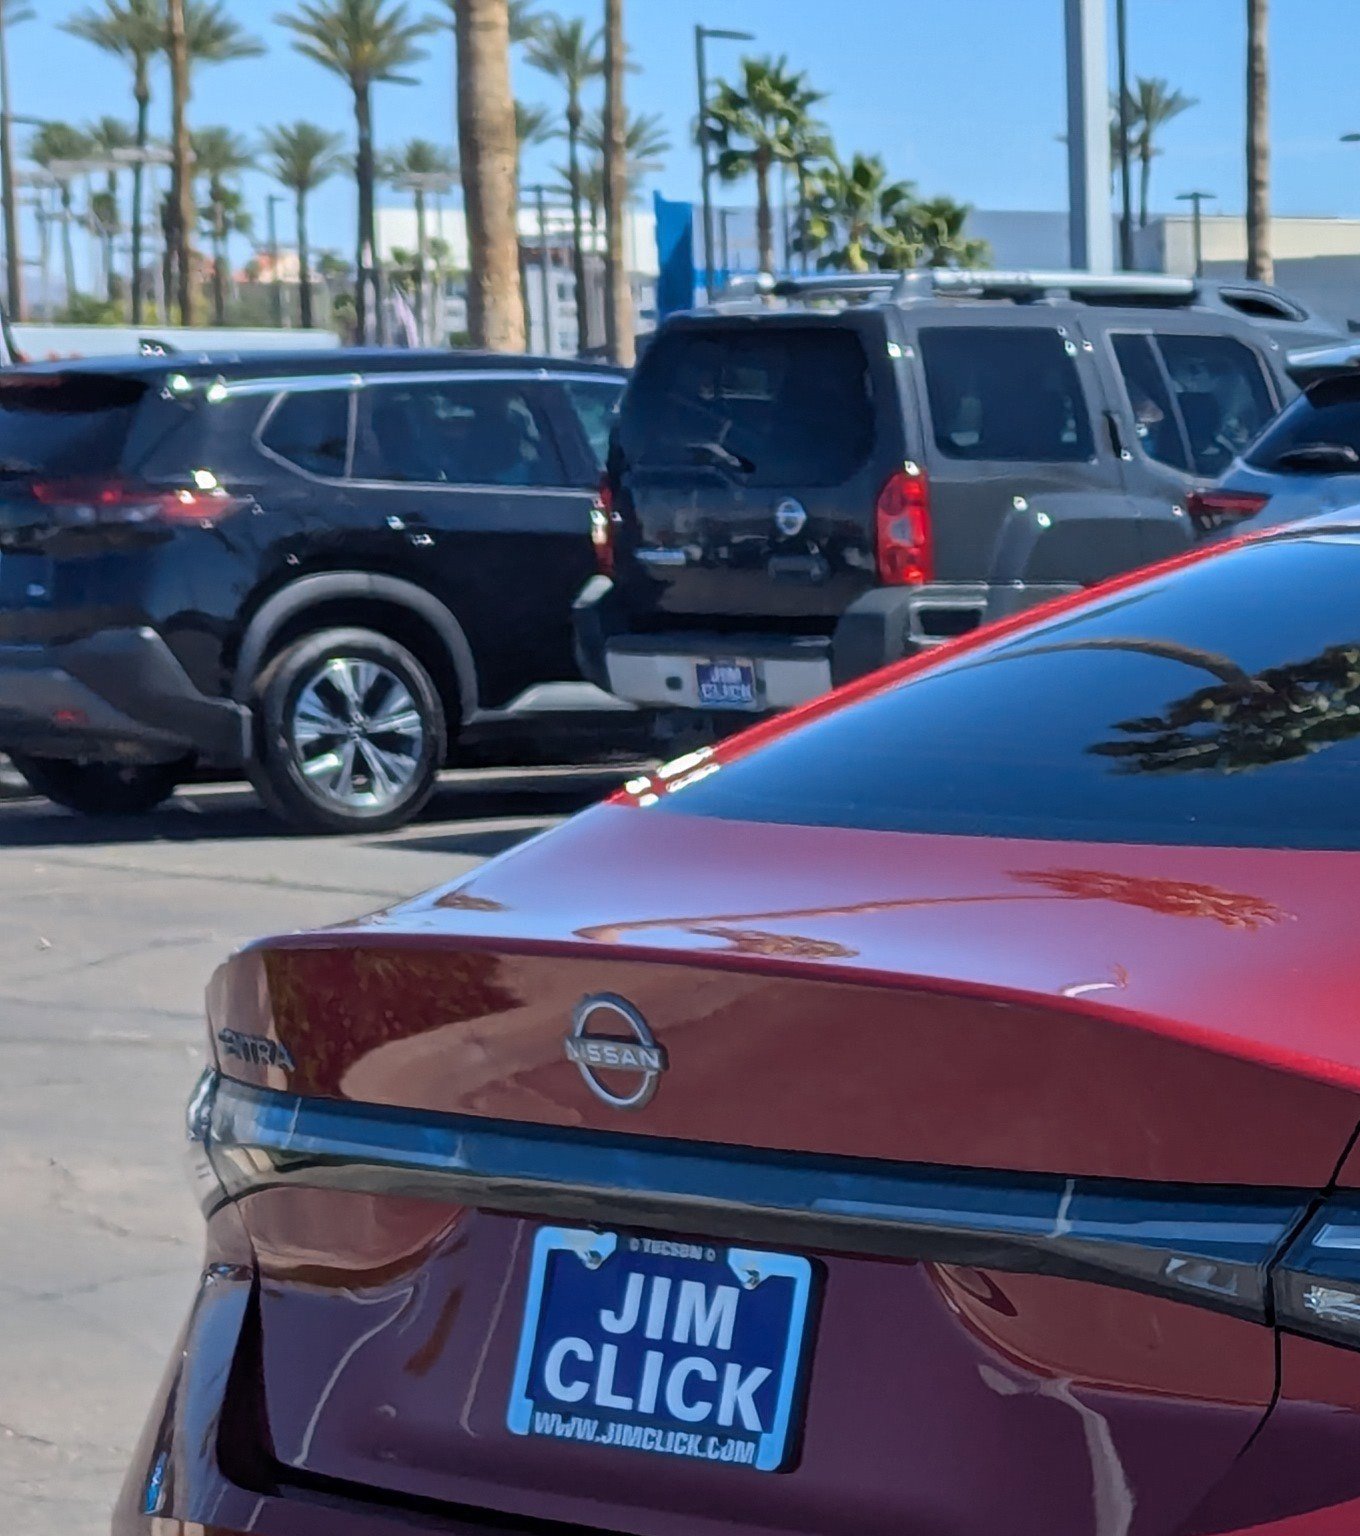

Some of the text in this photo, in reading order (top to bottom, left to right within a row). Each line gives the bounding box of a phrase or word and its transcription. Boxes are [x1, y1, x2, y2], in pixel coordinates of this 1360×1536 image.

[564, 1037, 661, 1069] NISSAN
[600, 1272, 740, 1350] JIM
[544, 1336, 773, 1432] CLICK
[534, 1411, 756, 1464] WWW.JIMCLICK.COM
